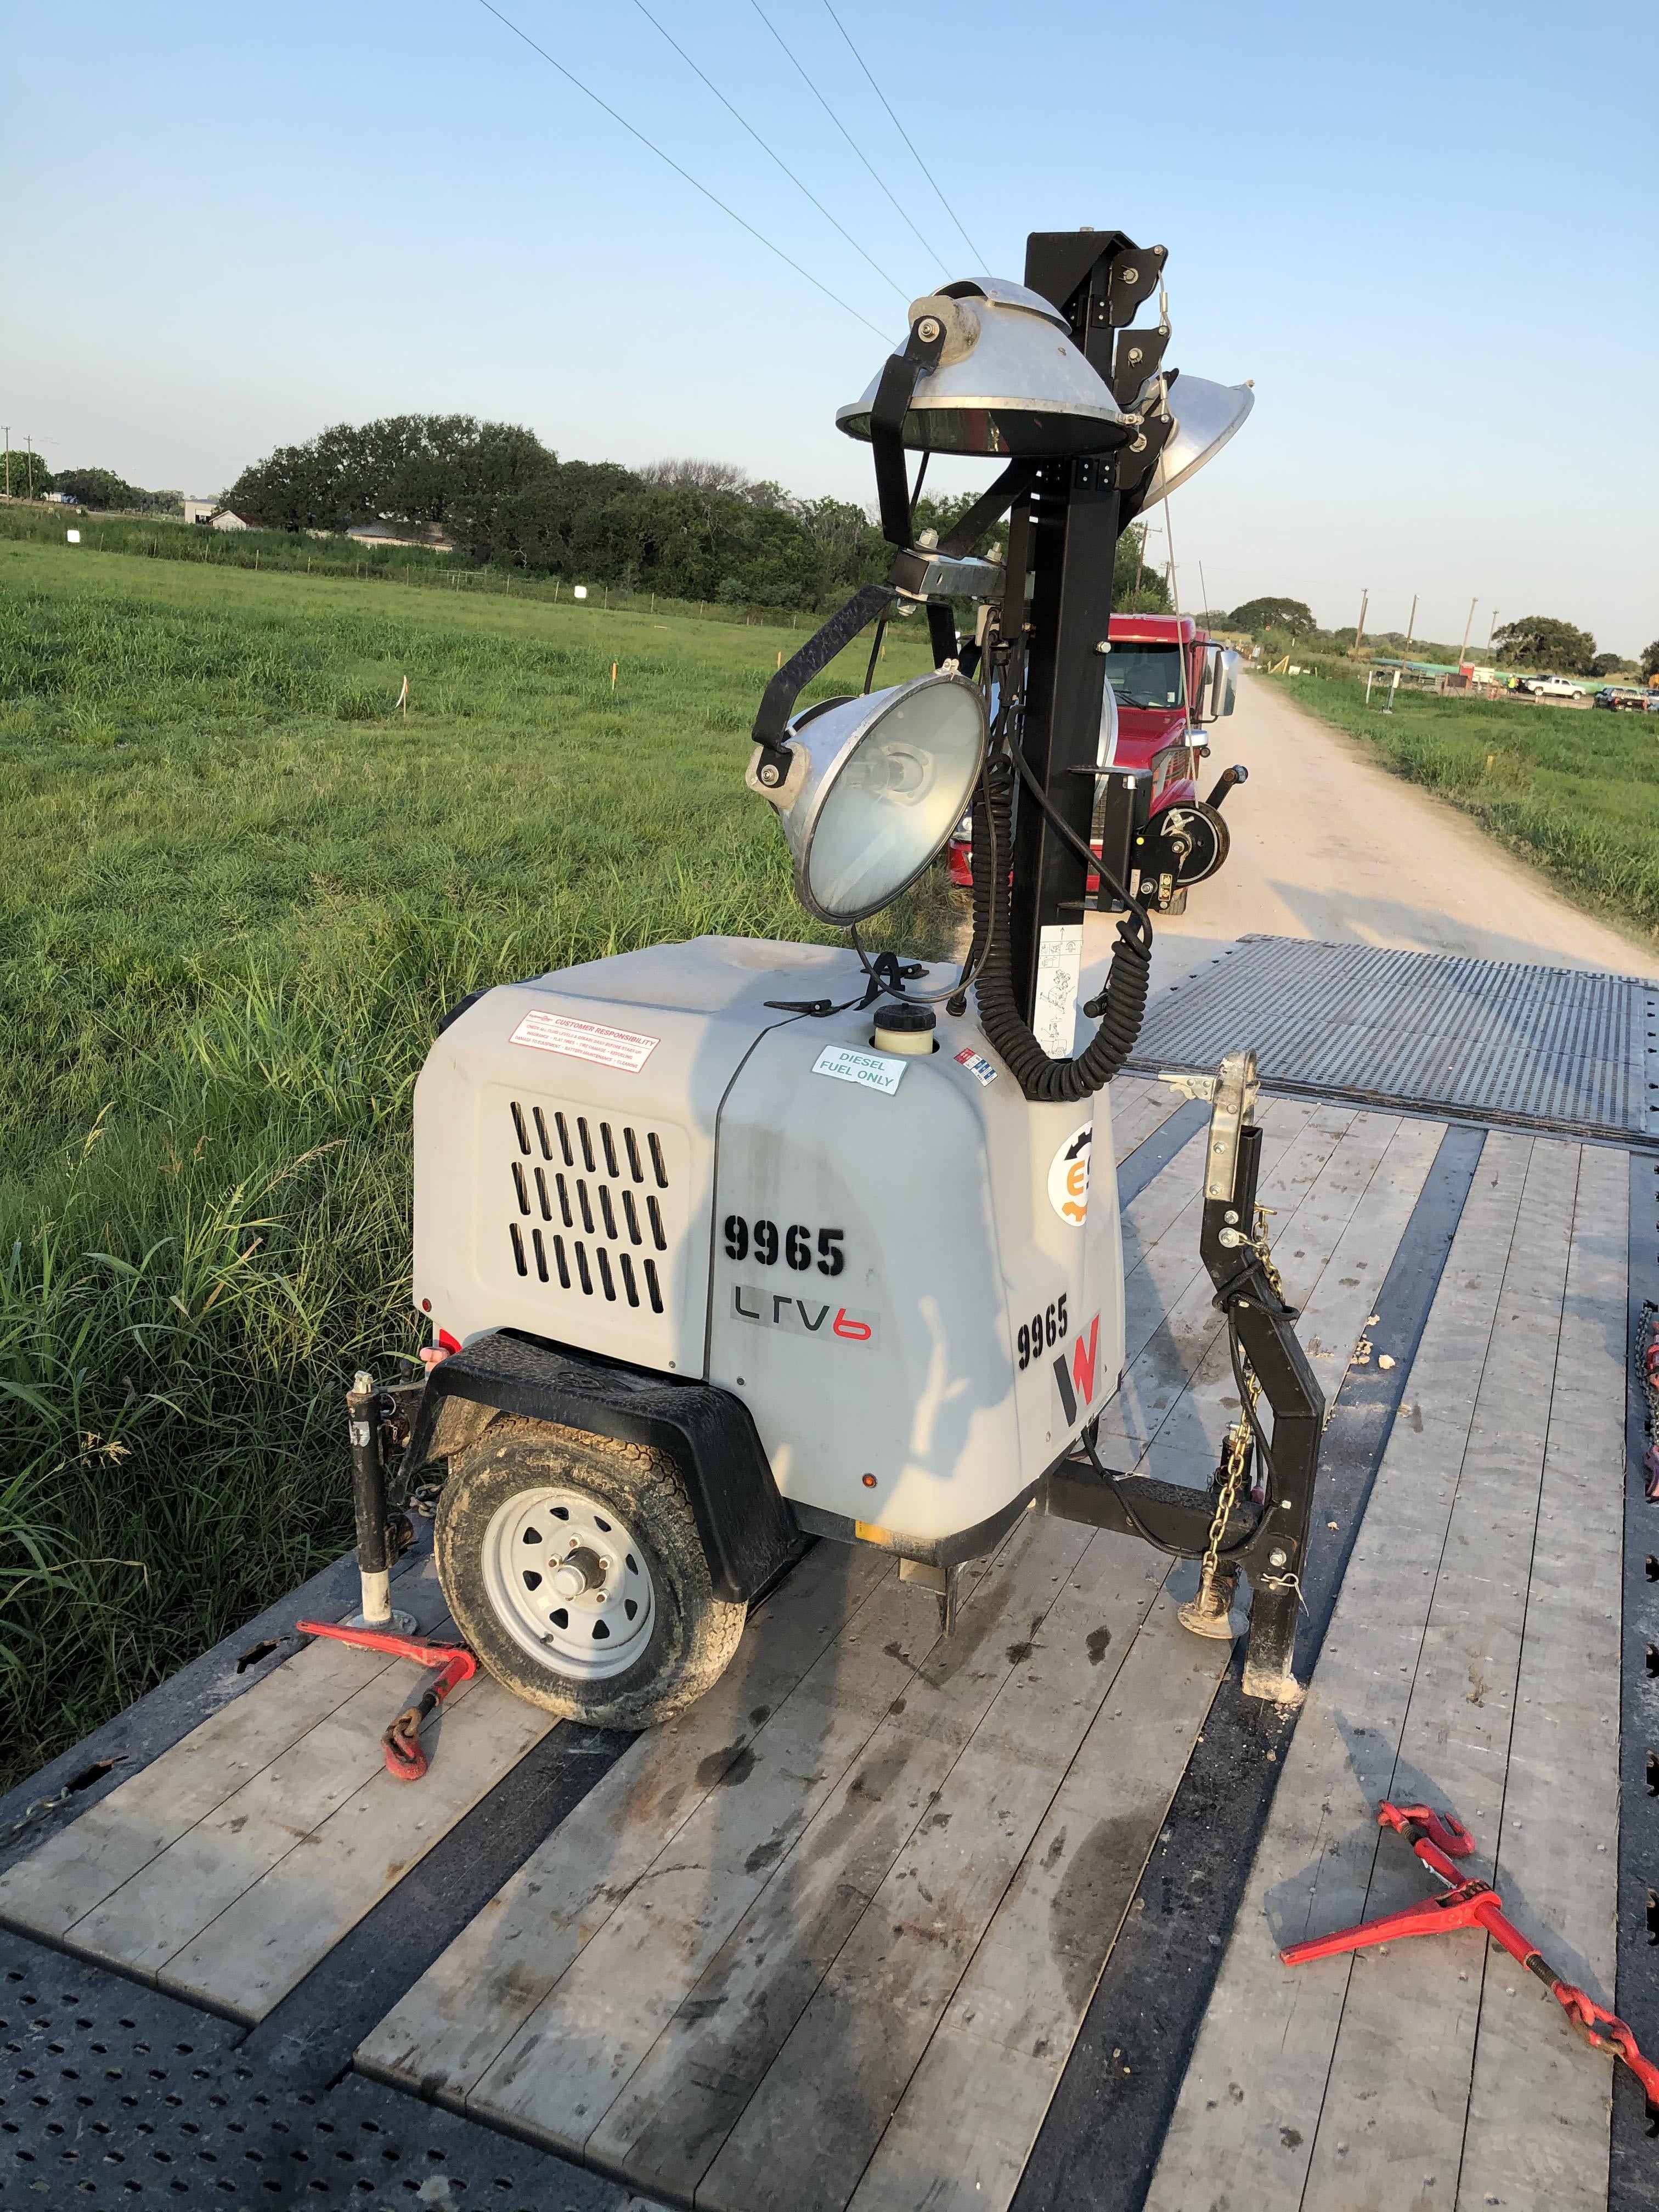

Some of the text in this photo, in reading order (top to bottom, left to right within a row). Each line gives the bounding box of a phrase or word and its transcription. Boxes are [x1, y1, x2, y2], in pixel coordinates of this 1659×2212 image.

[555, 1019, 655, 1046] CUSTOMER RESPONSIBILITY
[583, 1051, 612, 1061] MAINTENANCE
[617, 1060, 638, 1068] CLEANING
[610, 1051, 633, 1059] REFUELING
[839, 1053, 885, 1071] DIESEL
[820, 1060, 894, 1087] FUEL ONLY
[724, 1215, 845, 1276] 9965
[1018, 1292, 1068, 1370] 9965
